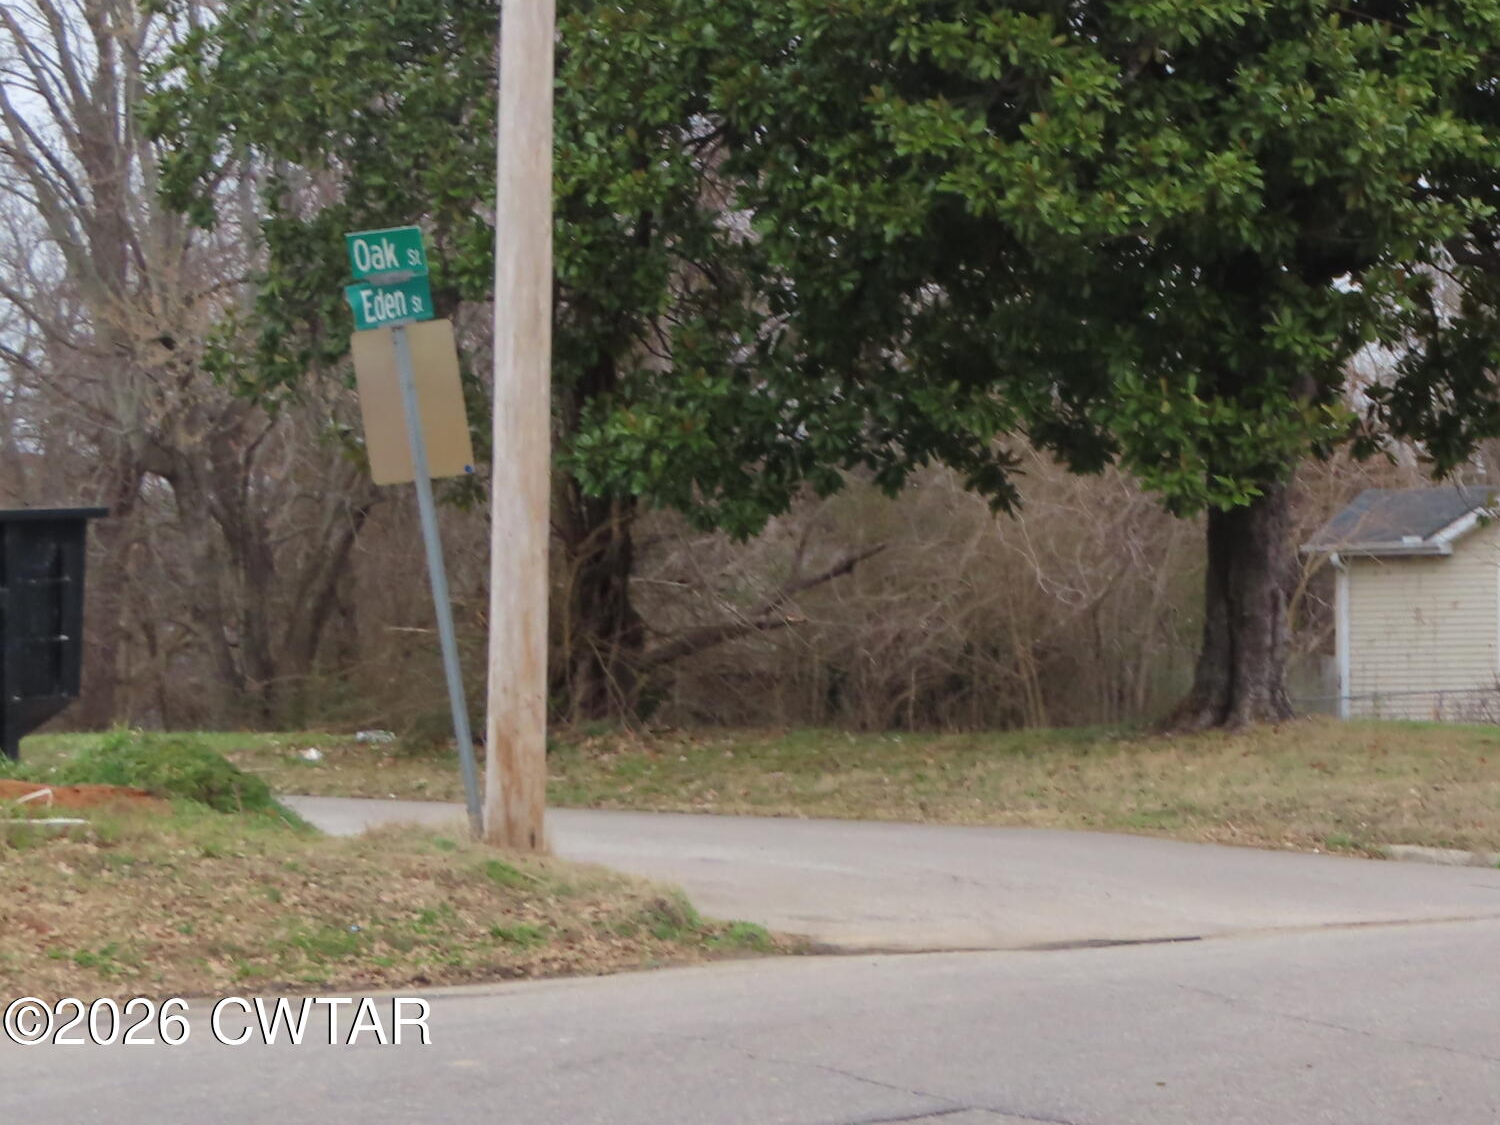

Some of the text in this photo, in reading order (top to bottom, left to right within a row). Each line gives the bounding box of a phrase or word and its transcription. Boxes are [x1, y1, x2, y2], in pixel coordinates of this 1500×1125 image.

[353, 237, 422, 272] Oak St
[360, 288, 424, 323] Eden St
